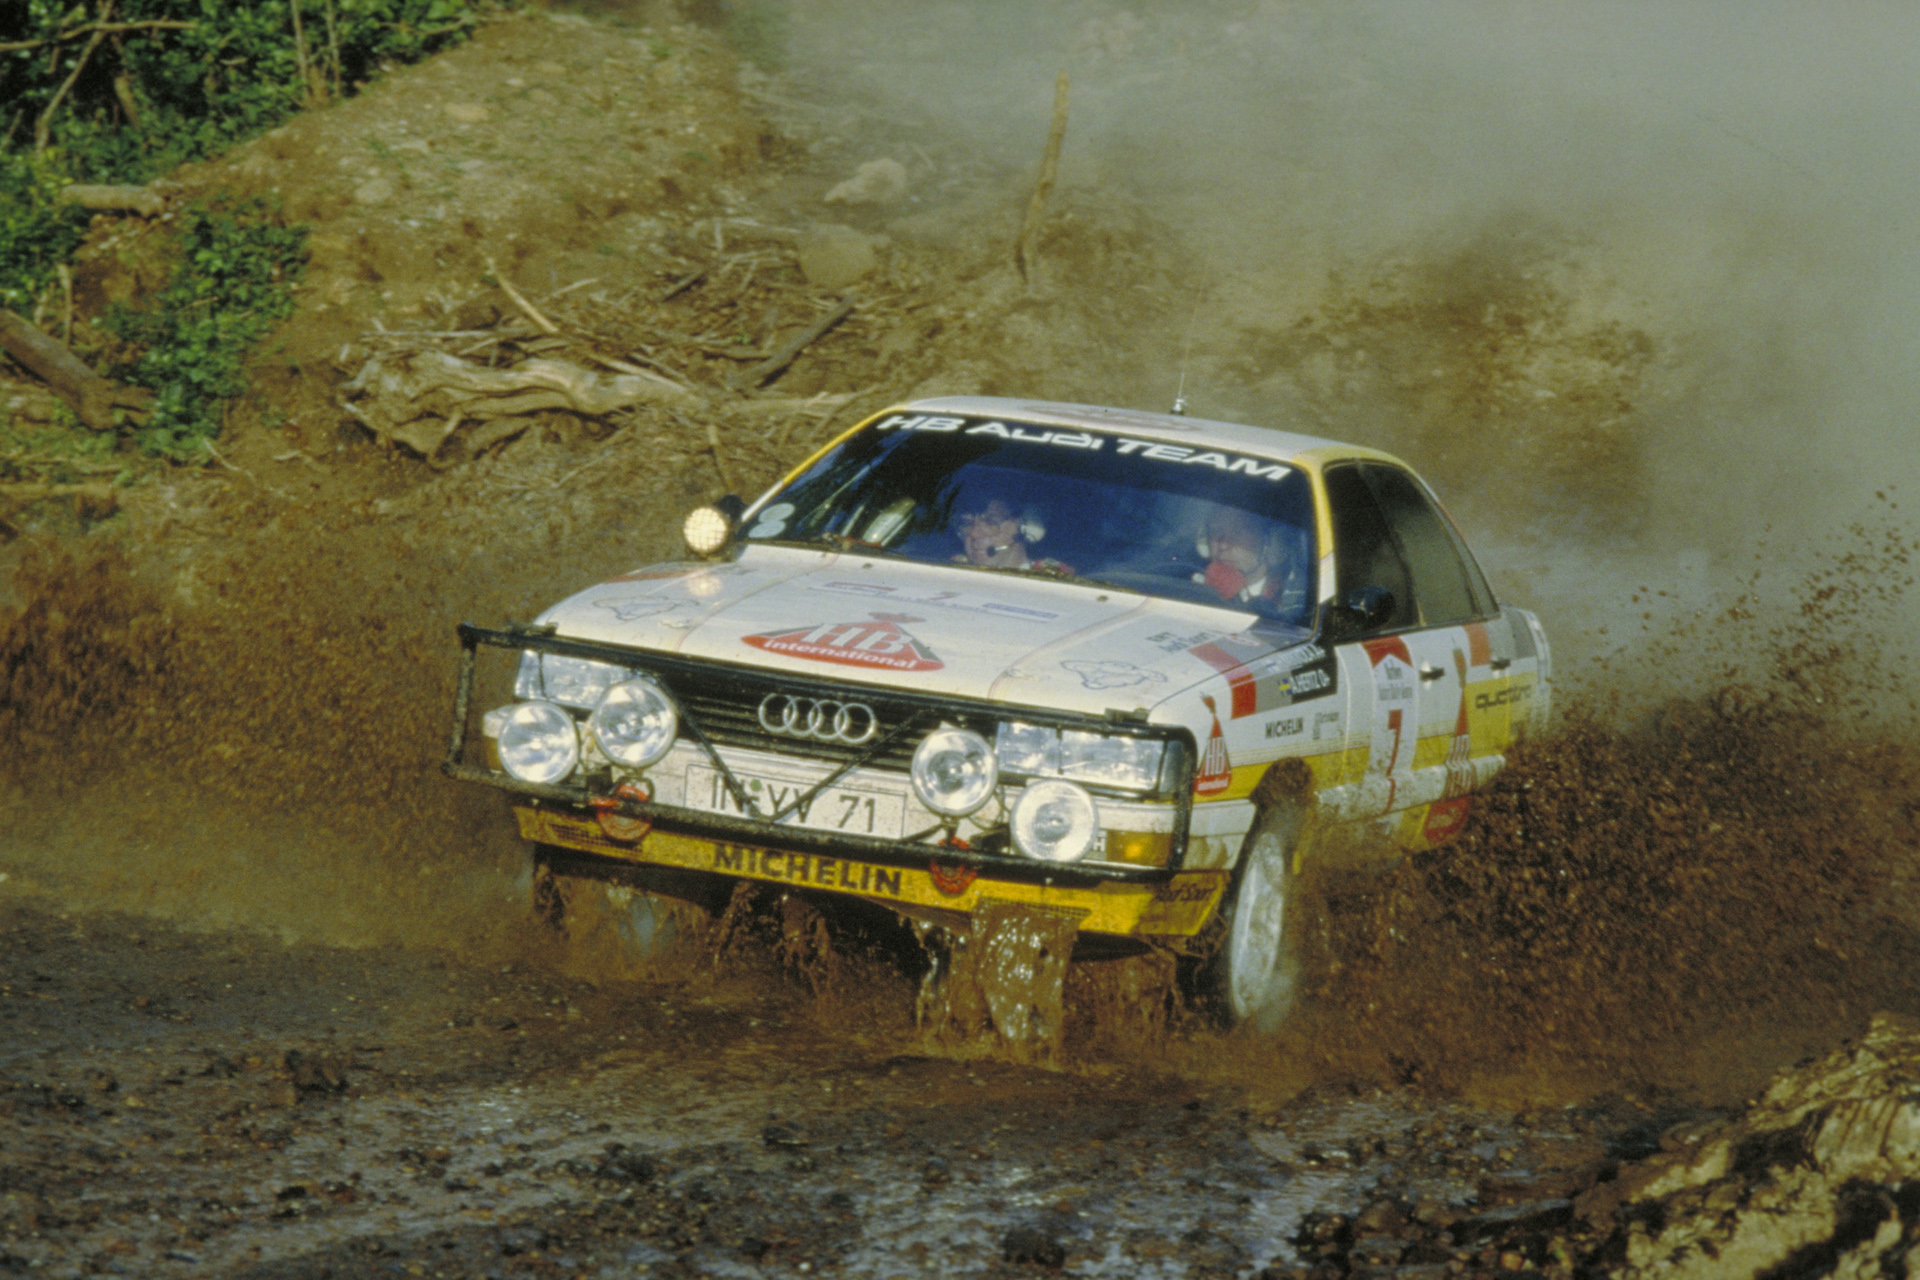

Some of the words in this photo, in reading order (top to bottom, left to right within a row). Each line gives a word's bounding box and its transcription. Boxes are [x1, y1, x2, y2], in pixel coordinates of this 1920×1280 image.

[876, 415, 965, 432] HB
[965, 421, 1104, 451] Audi
[1116, 437, 1292, 481] TEAM
[763, 640, 918, 669] international
[801, 624, 913, 654] HB
[1265, 716, 1304, 740] MICHELIN
[1204, 736, 1228, 777] HB
[838, 794, 876, 833] 71
[714, 844, 902, 895] MICHELIN
